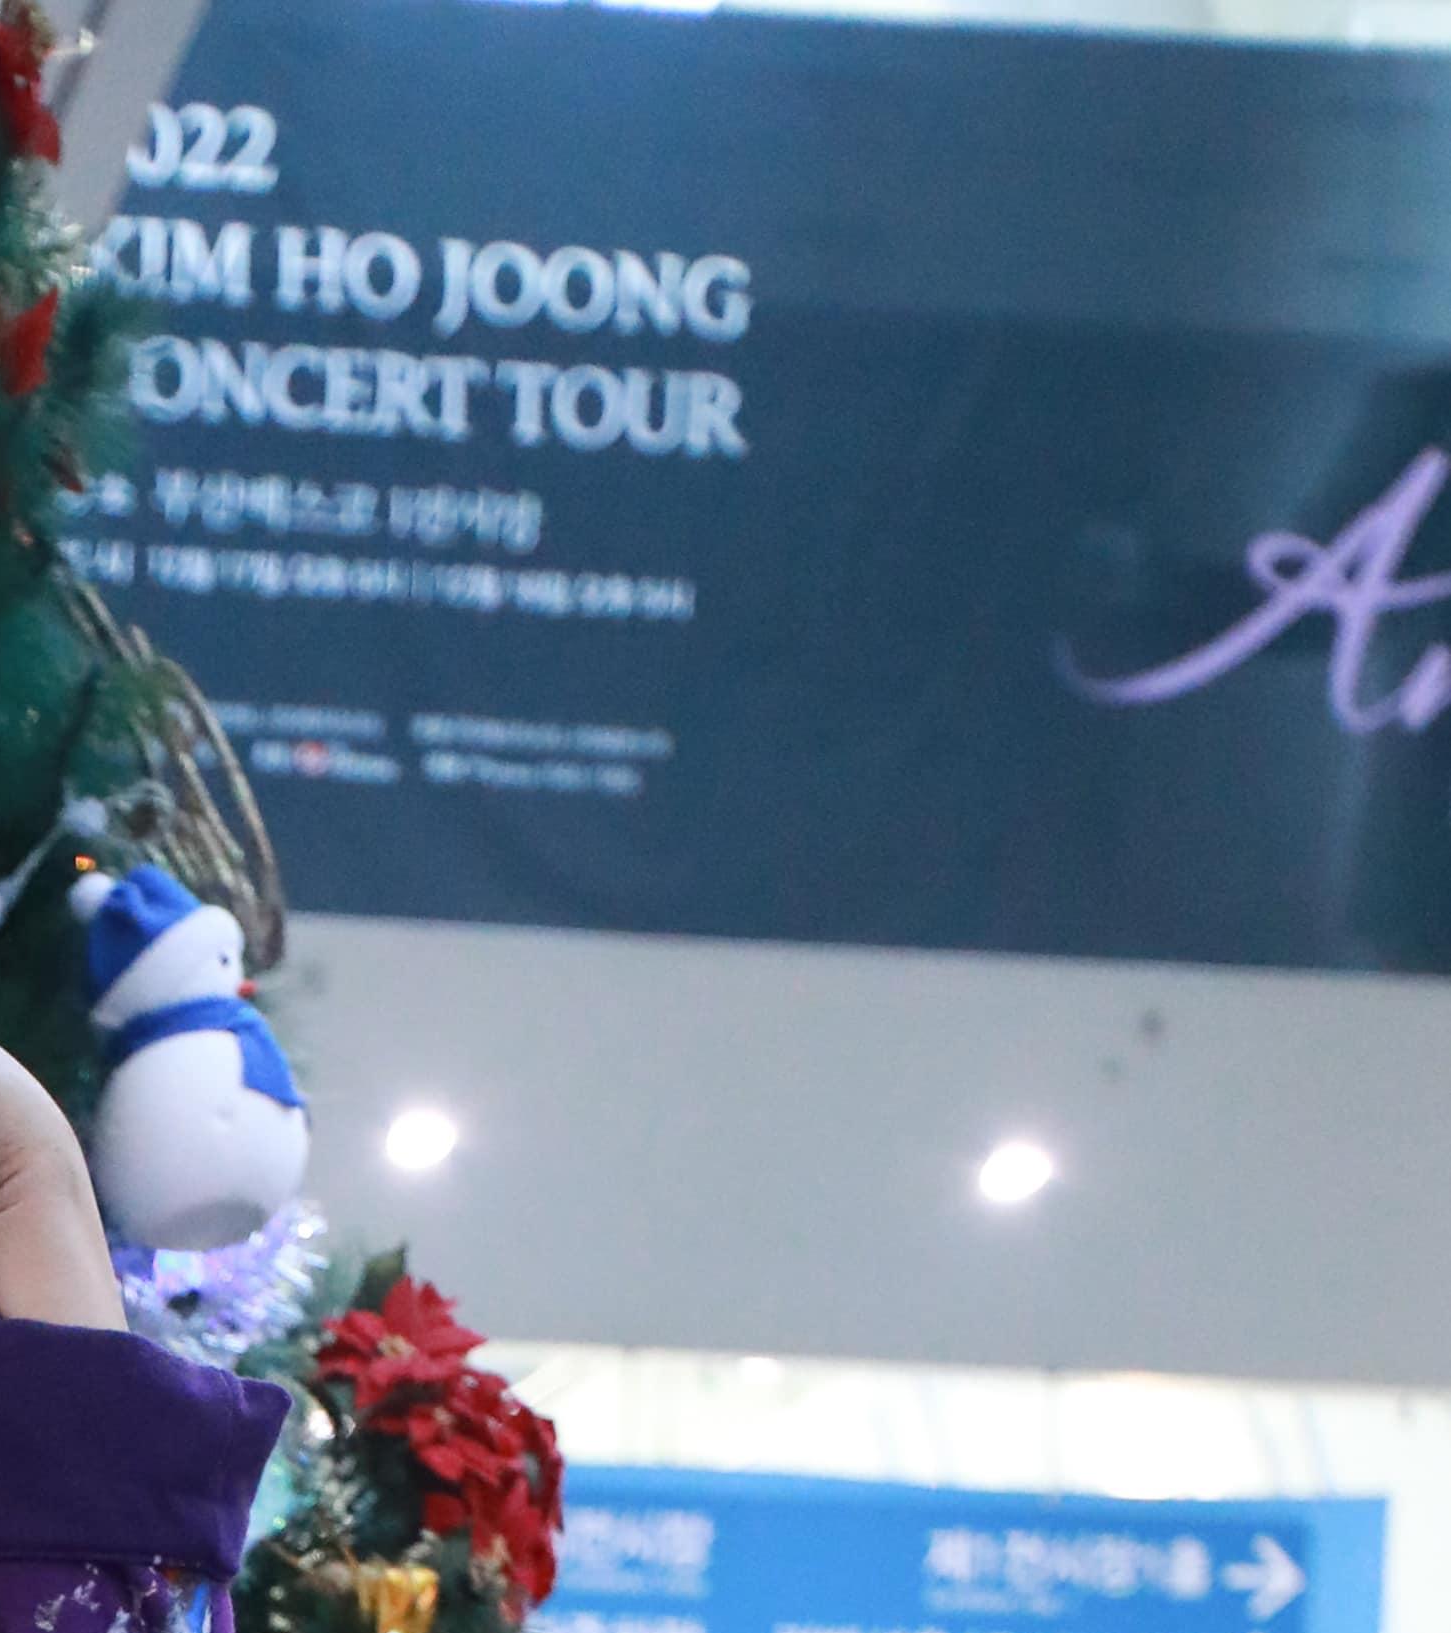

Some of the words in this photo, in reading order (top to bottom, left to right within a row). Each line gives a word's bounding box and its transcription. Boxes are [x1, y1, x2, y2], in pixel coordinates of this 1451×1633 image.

[275, 224, 422, 322] HO
[433, 236, 753, 342] JOONG
[127, 333, 489, 442] ONCERT
[497, 358, 749, 460] TOUR
